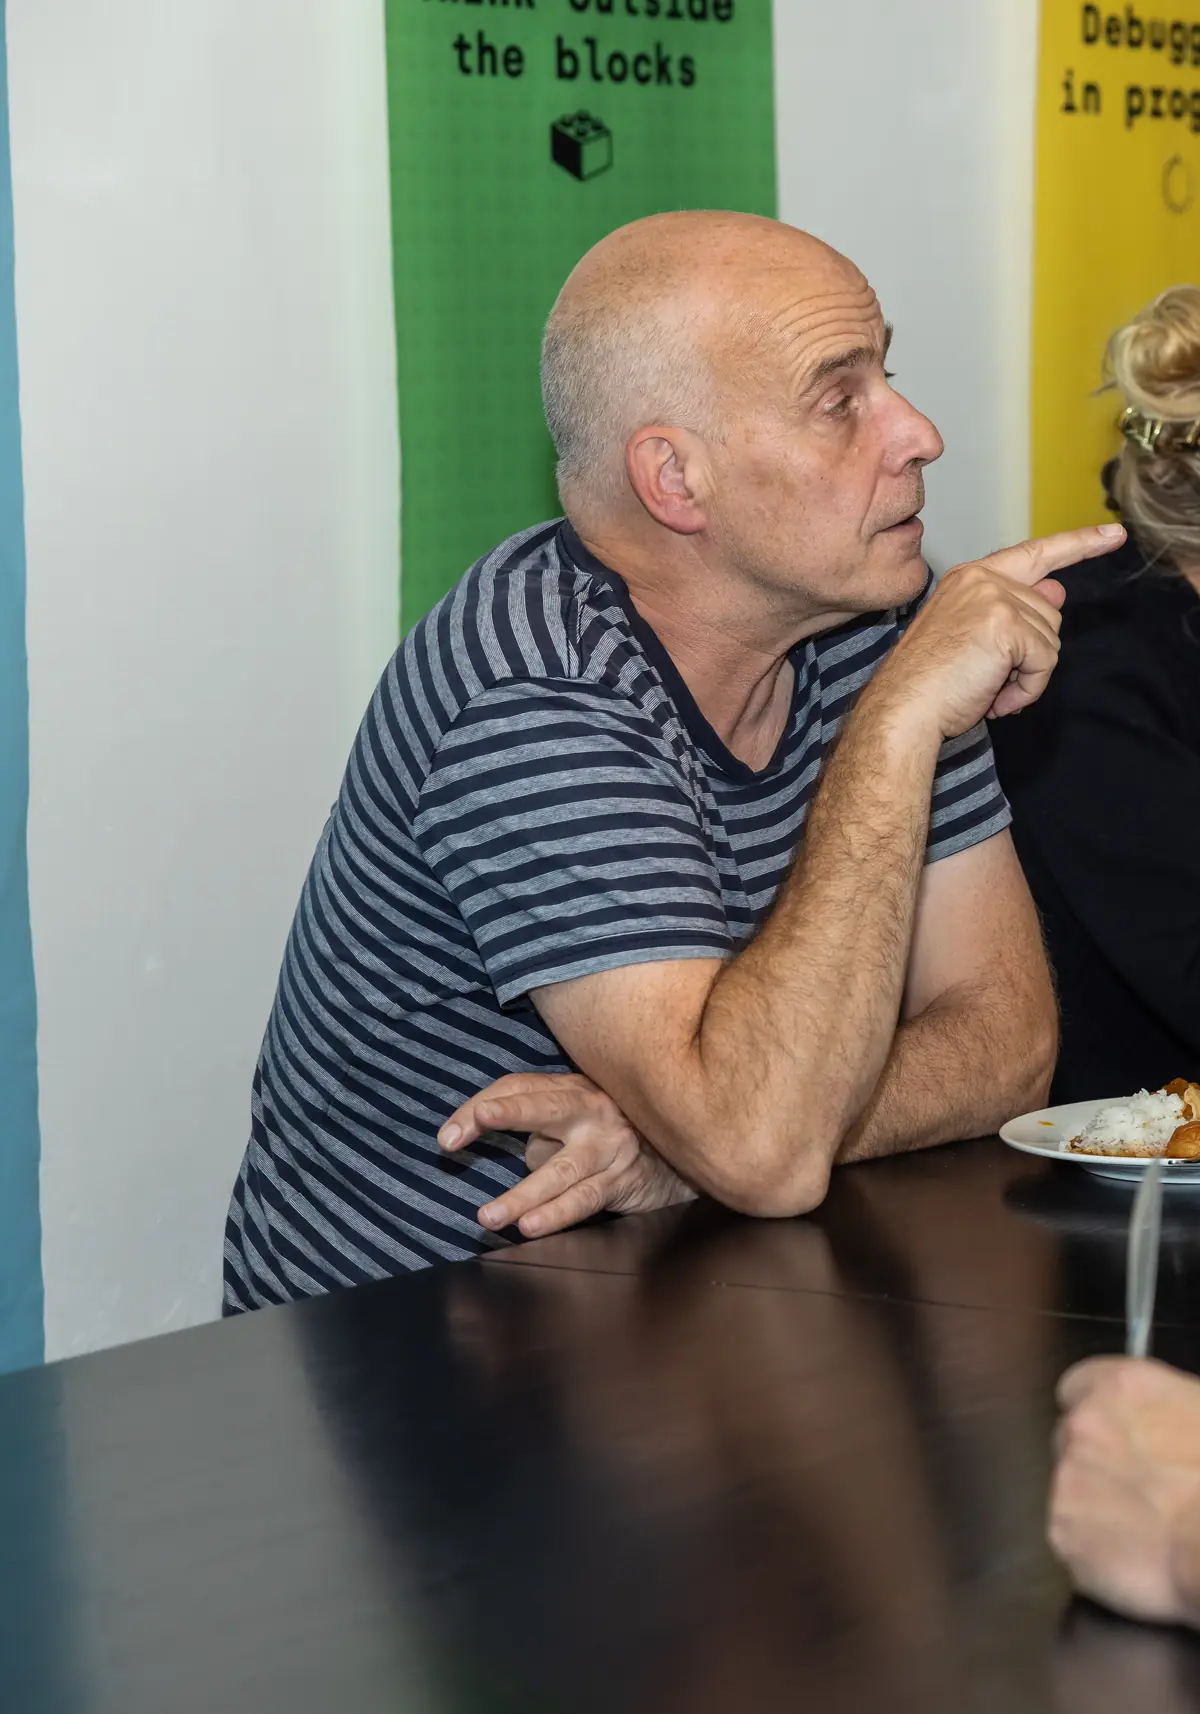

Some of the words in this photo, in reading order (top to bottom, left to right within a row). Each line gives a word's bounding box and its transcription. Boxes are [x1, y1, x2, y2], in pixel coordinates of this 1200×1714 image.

[452, 30, 525, 78] the
[555, 34, 697, 88] blocks
[1061, 68, 1101, 114] in
